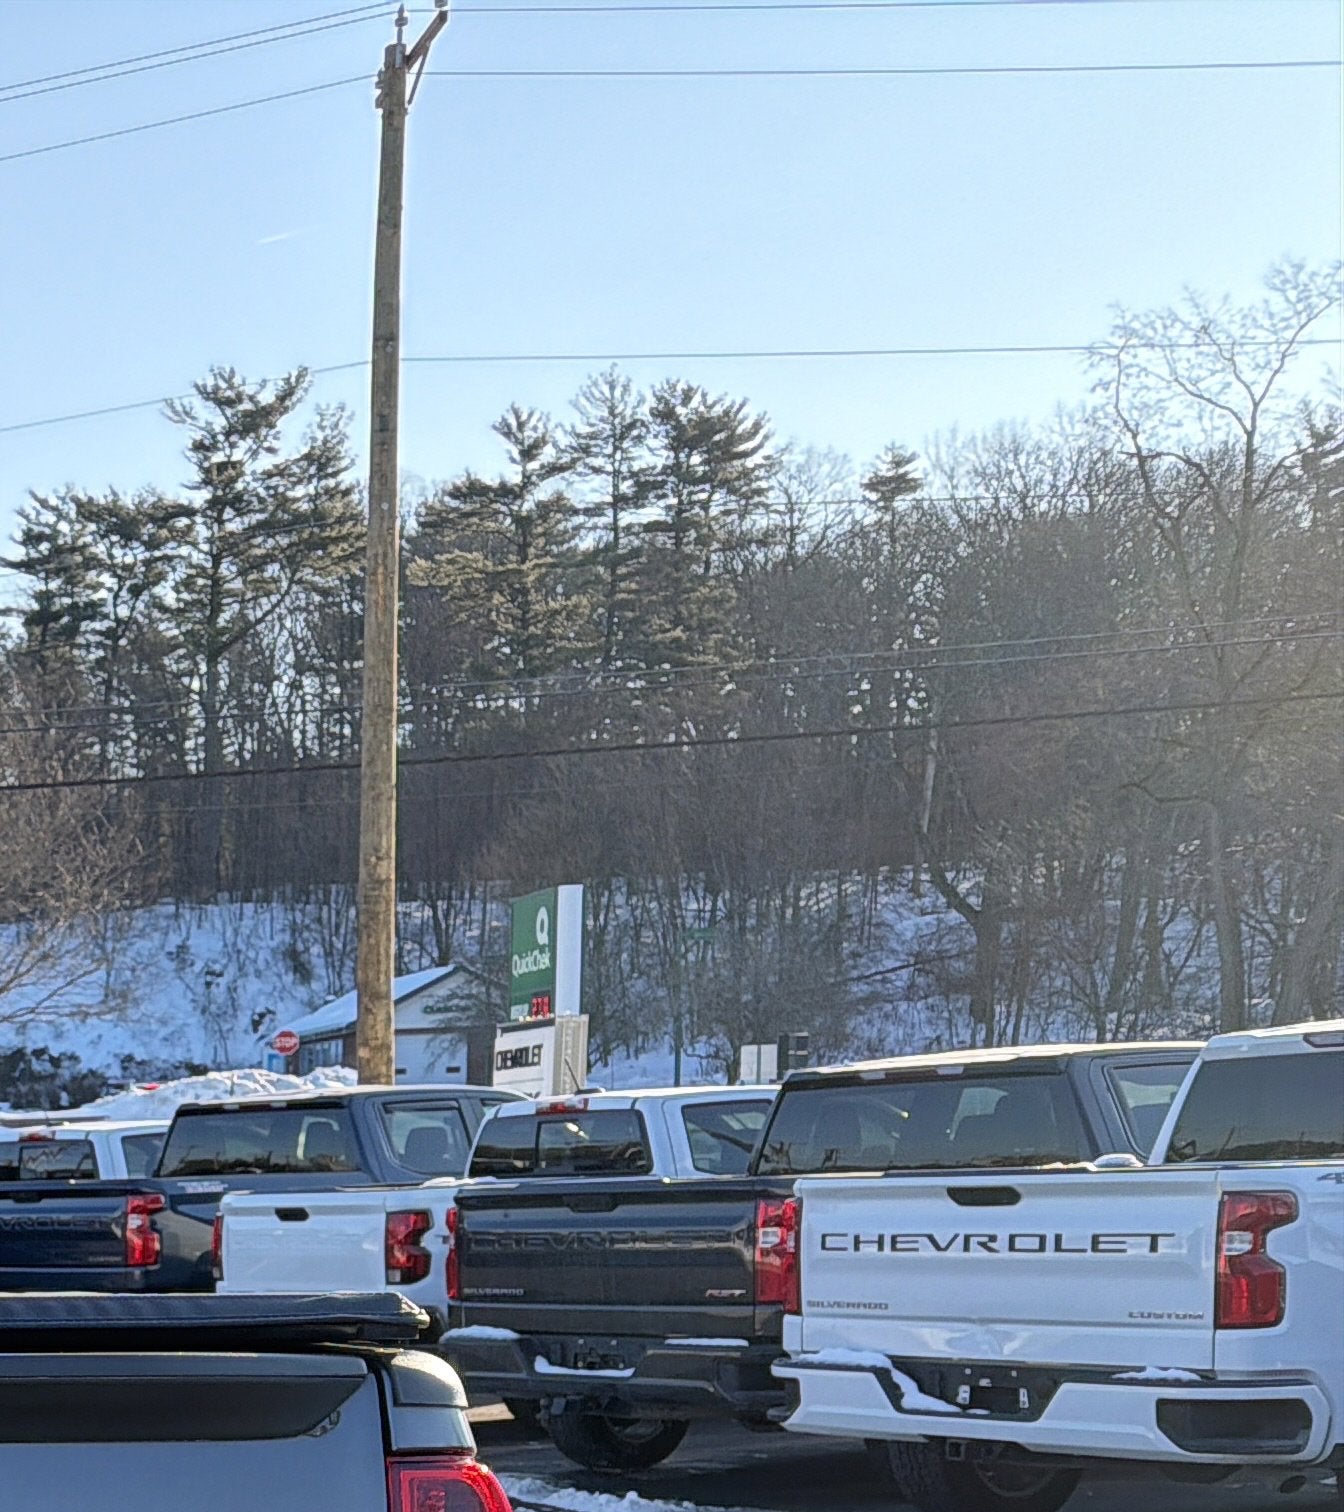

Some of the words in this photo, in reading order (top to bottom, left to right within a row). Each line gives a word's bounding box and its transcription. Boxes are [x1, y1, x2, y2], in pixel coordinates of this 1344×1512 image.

[512, 947, 551, 978] QuickChek
[821, 1232, 1175, 1254] CHEVROLET
[807, 1300, 889, 1311] SILVERADO
[1128, 1311, 1204, 1320] CUSTOM
